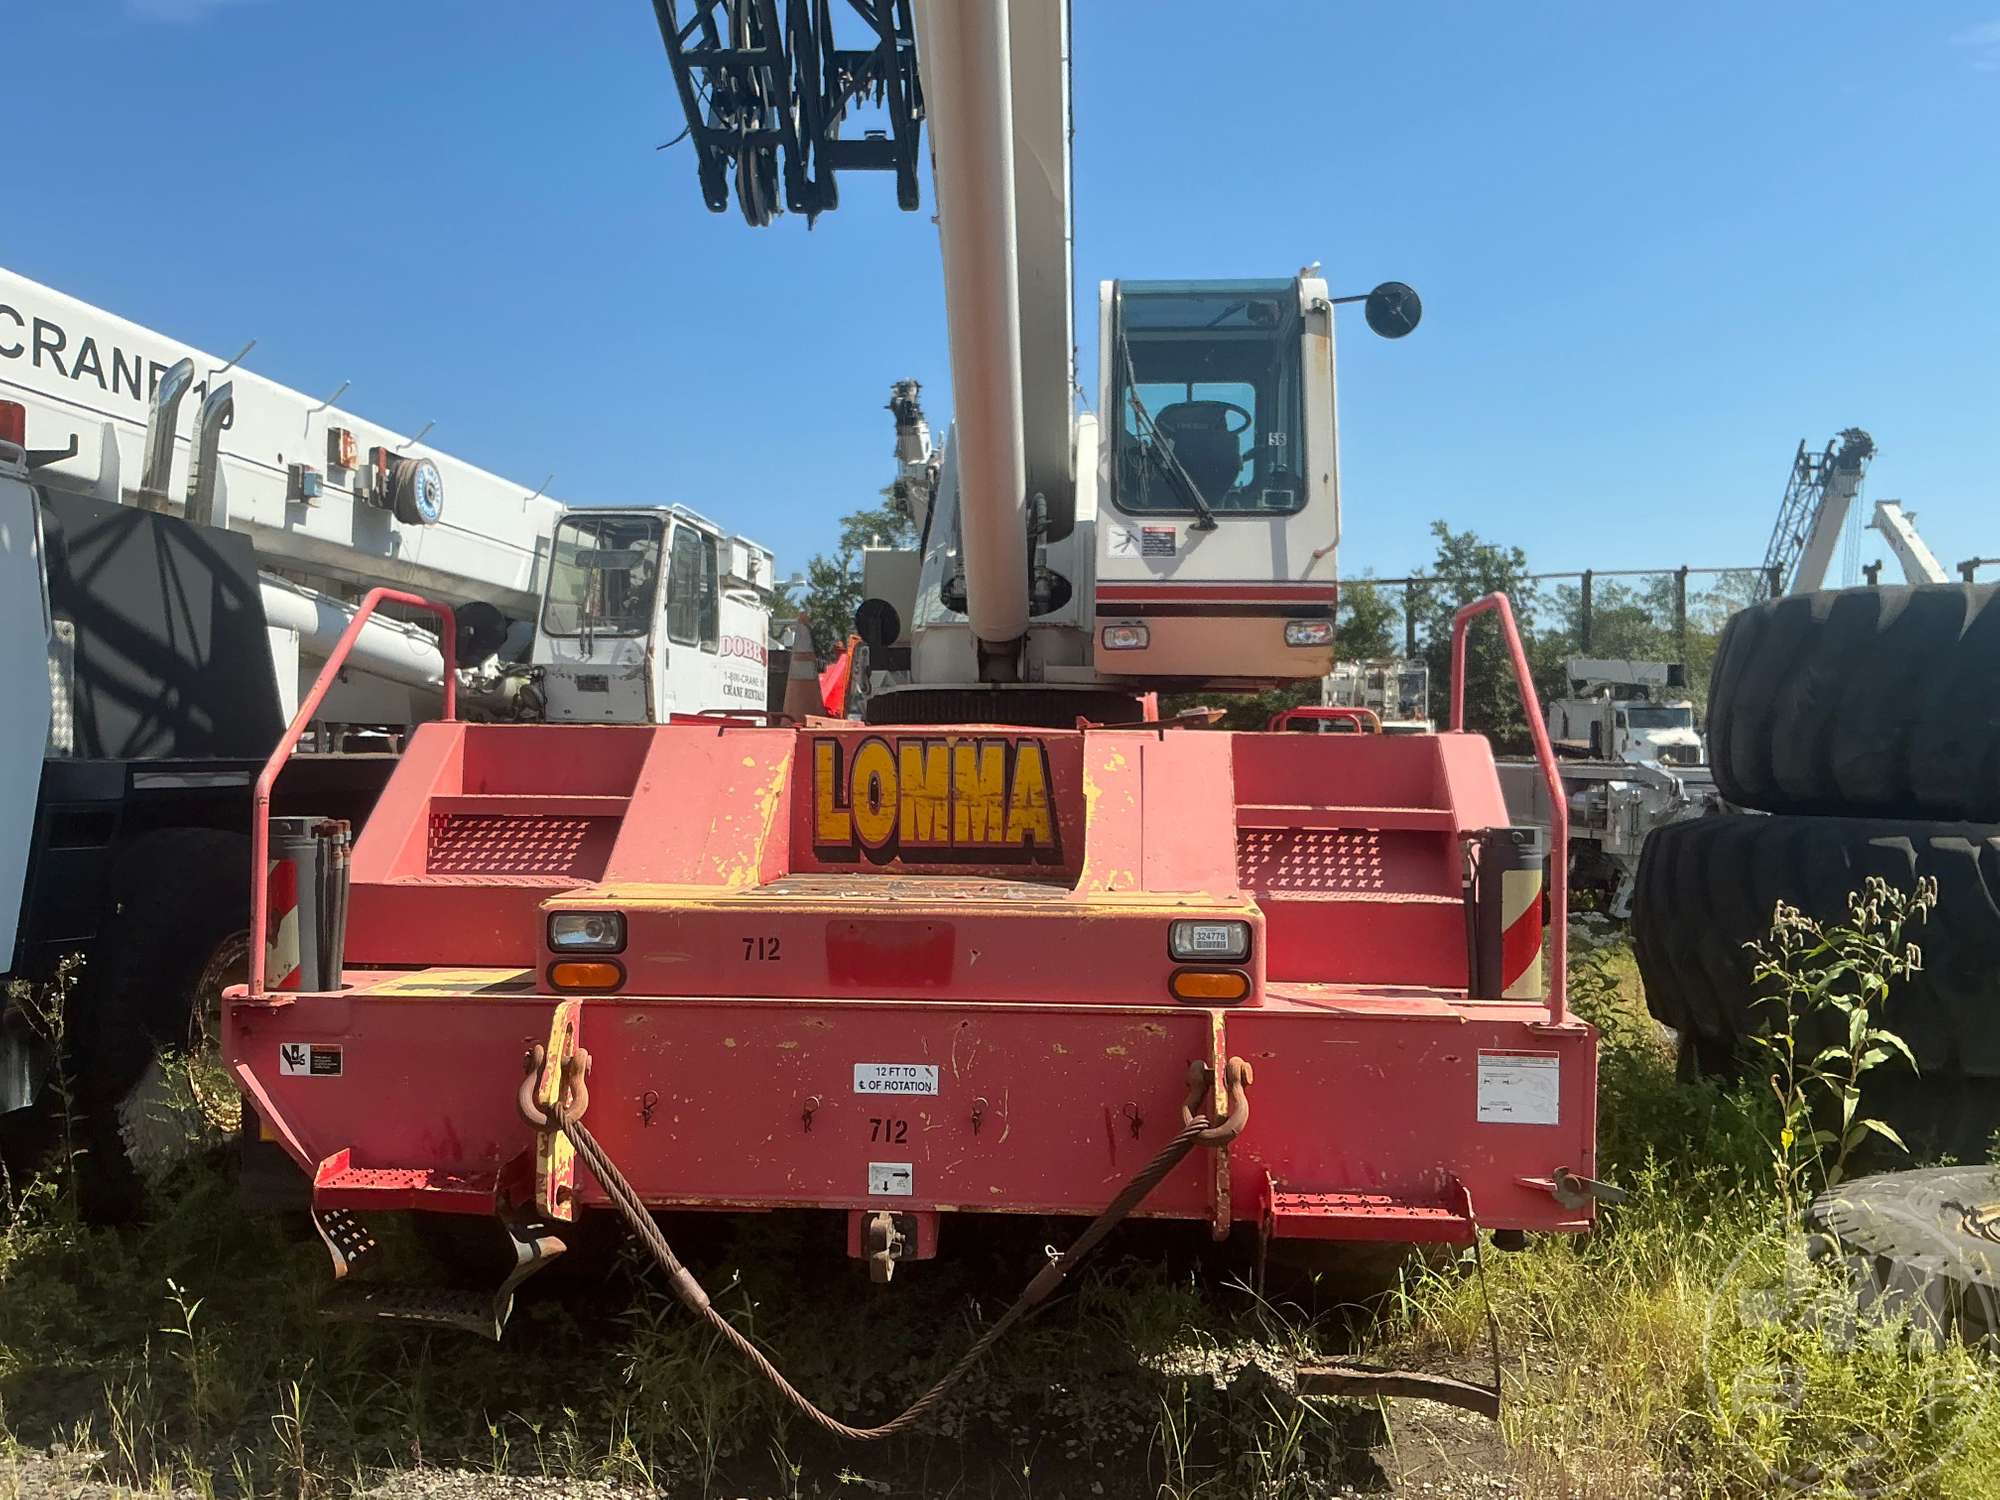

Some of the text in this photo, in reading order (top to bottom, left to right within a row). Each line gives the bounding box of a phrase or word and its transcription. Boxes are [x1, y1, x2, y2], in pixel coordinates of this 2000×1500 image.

[813, 736, 1062, 862] LOMMA
[742, 936, 781, 961] 712
[876, 1067, 917, 1078] 12 FT TO
[868, 1080, 882, 1090] OF
[884, 1081, 932, 1093] ROTATION
[869, 1118, 909, 1144] 712
